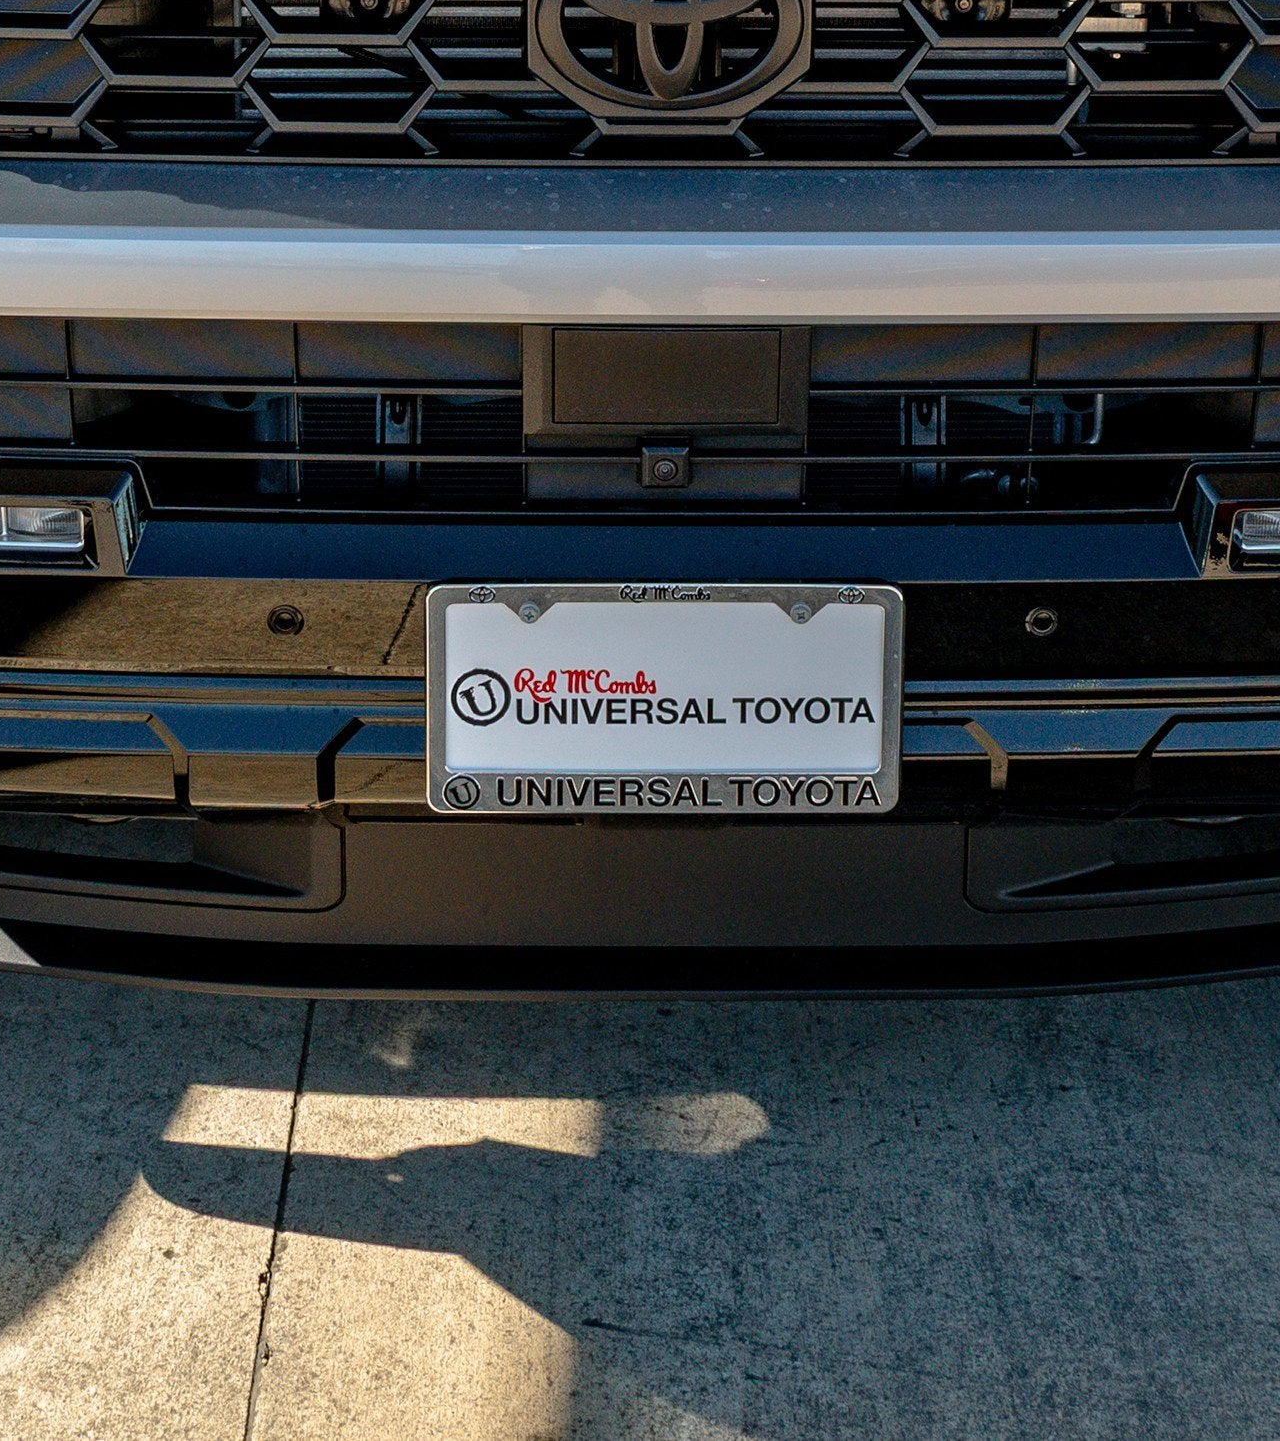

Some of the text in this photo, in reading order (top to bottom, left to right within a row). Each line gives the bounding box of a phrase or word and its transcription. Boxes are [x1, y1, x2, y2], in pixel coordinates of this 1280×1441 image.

[620, 585, 710, 603] Red McCombs
[514, 668, 656, 703] Red McCombs
[515, 697, 876, 725] UNIVERSAL TOYOTA
[497, 777, 722, 807] UNIVERSAL
[729, 777, 881, 807] TOYOTA
